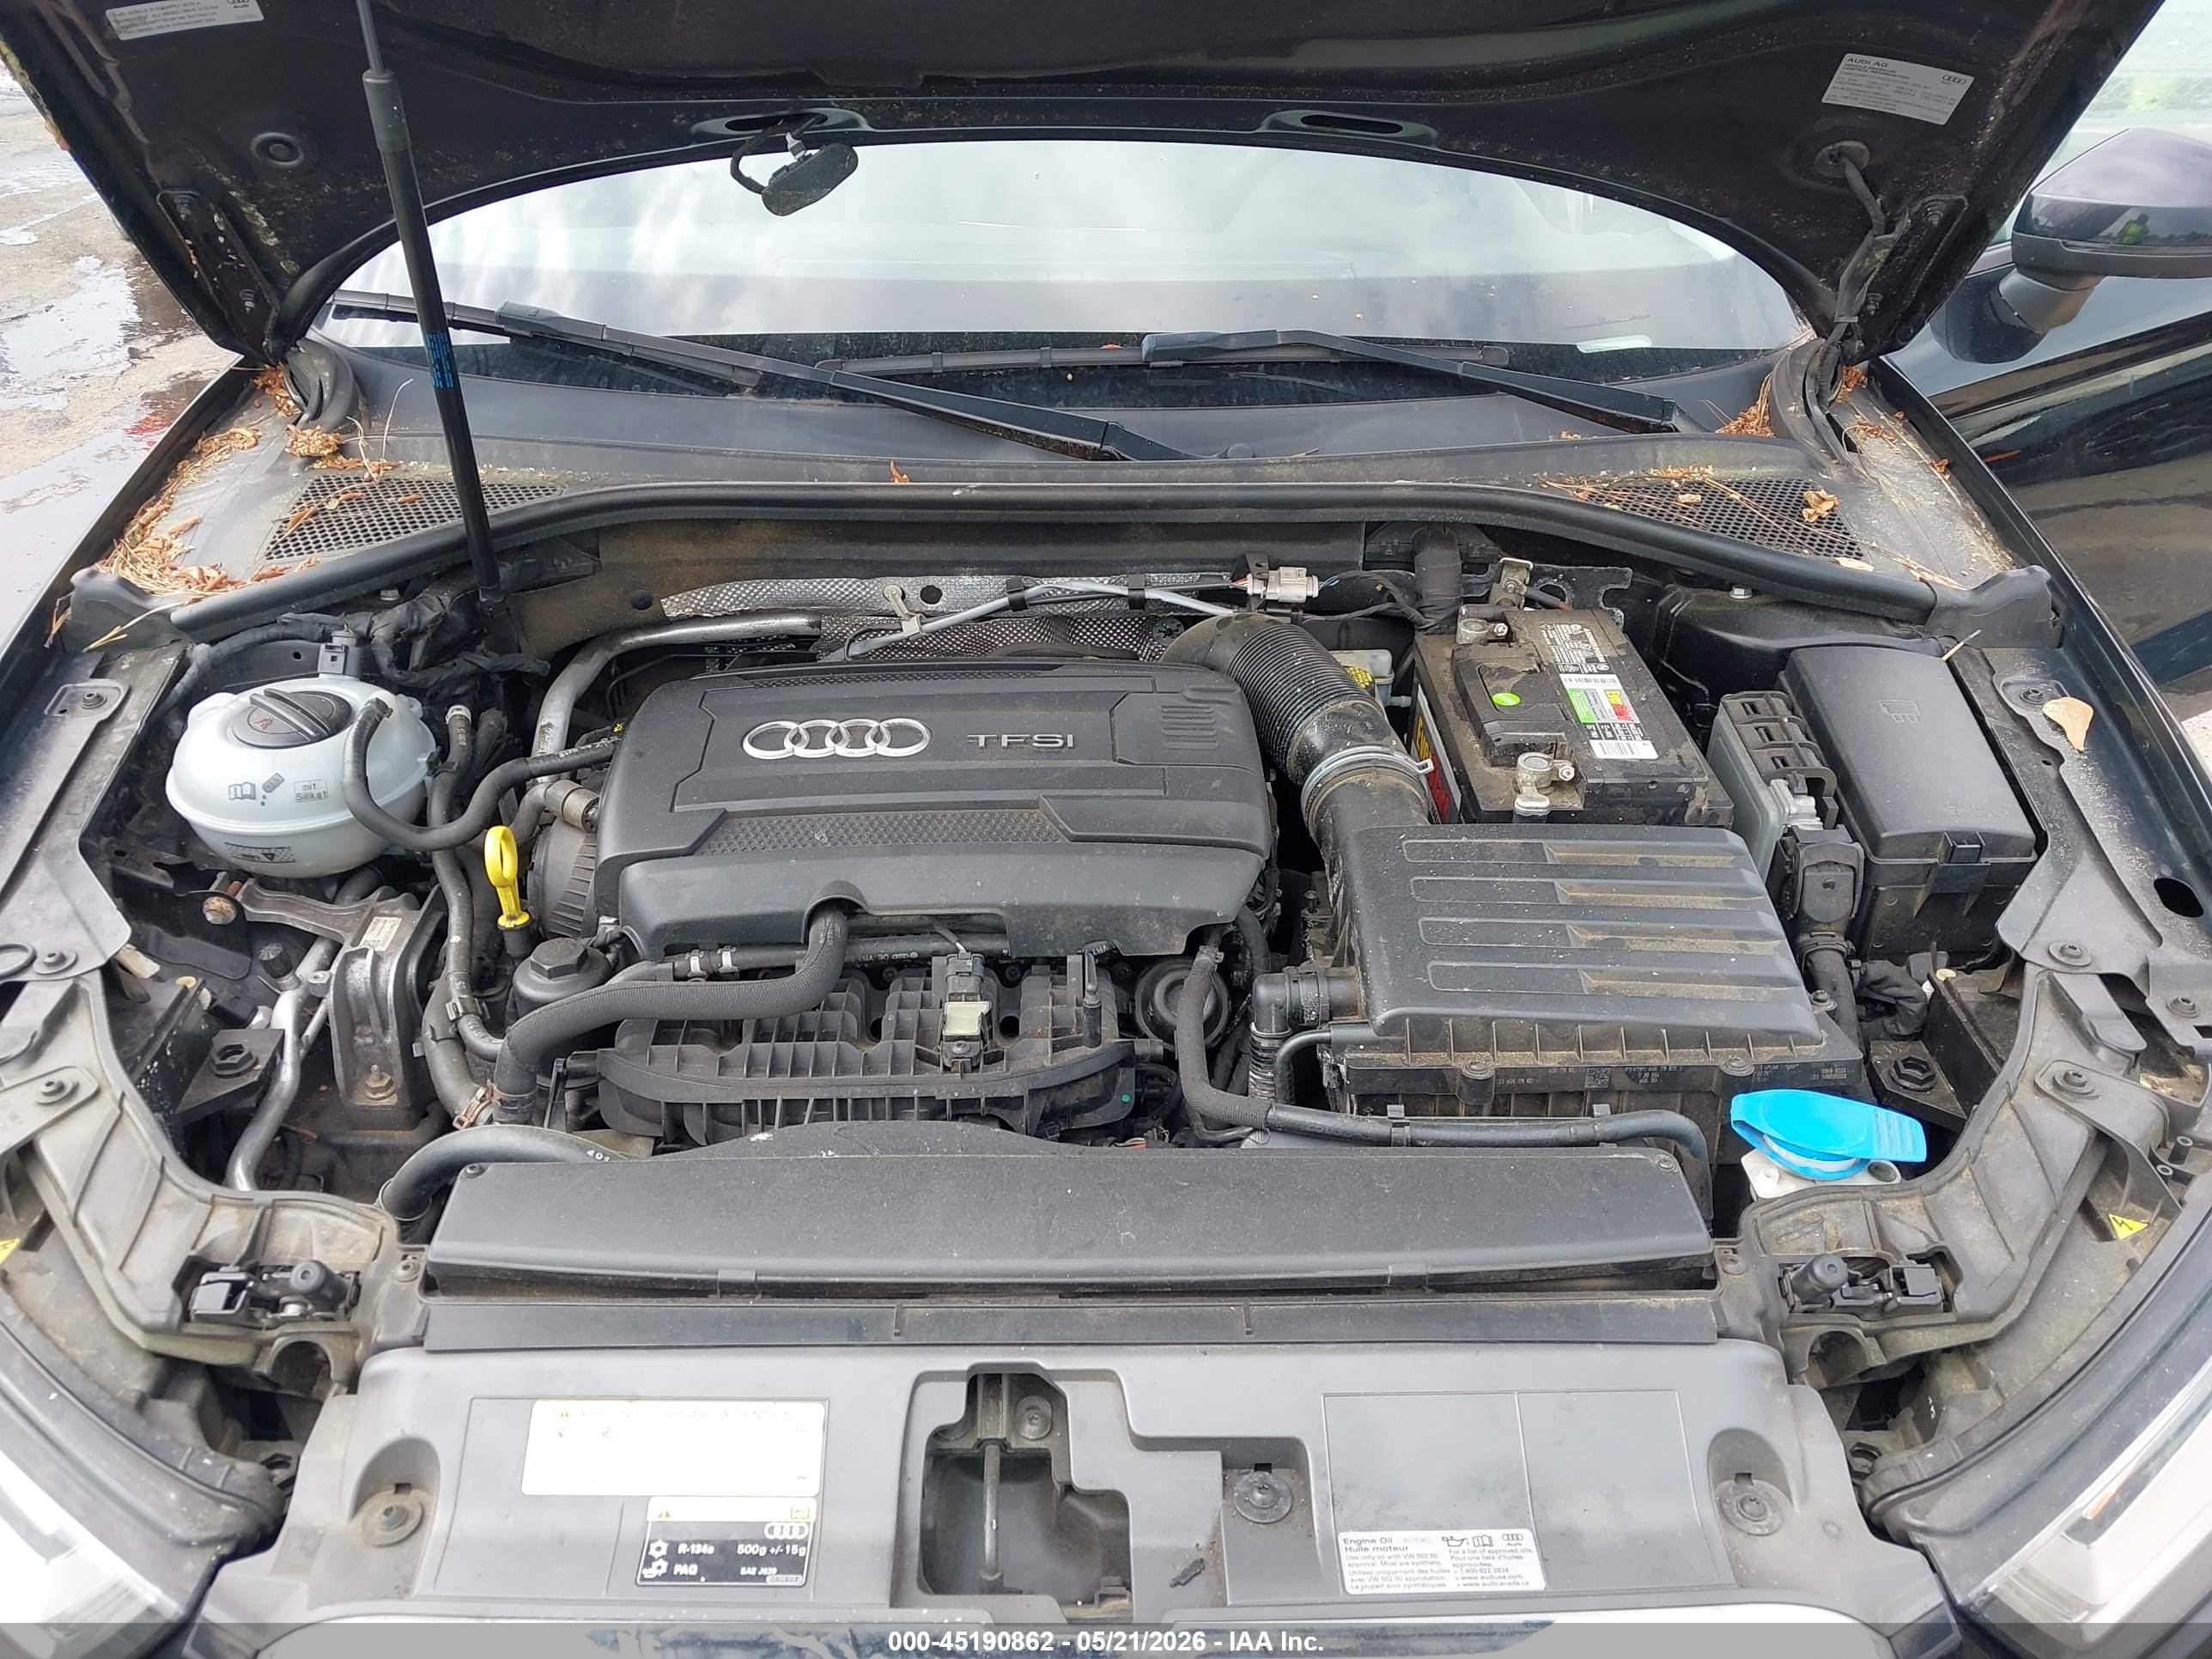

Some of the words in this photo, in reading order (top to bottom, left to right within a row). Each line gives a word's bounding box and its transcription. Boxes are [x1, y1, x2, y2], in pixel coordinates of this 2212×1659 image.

[1846, 57, 1871, 65] AUDI
[967, 733, 1073, 748] TFSI
[302, 782, 317, 791] mit
[1343, 1538, 1376, 1547] Engine
[1379, 1536, 1394, 1545] Oil
[737, 1543, 767, 1556] 500g
[769, 1545, 784, 1555] +/-
[785, 1544, 807, 1556] 15g
